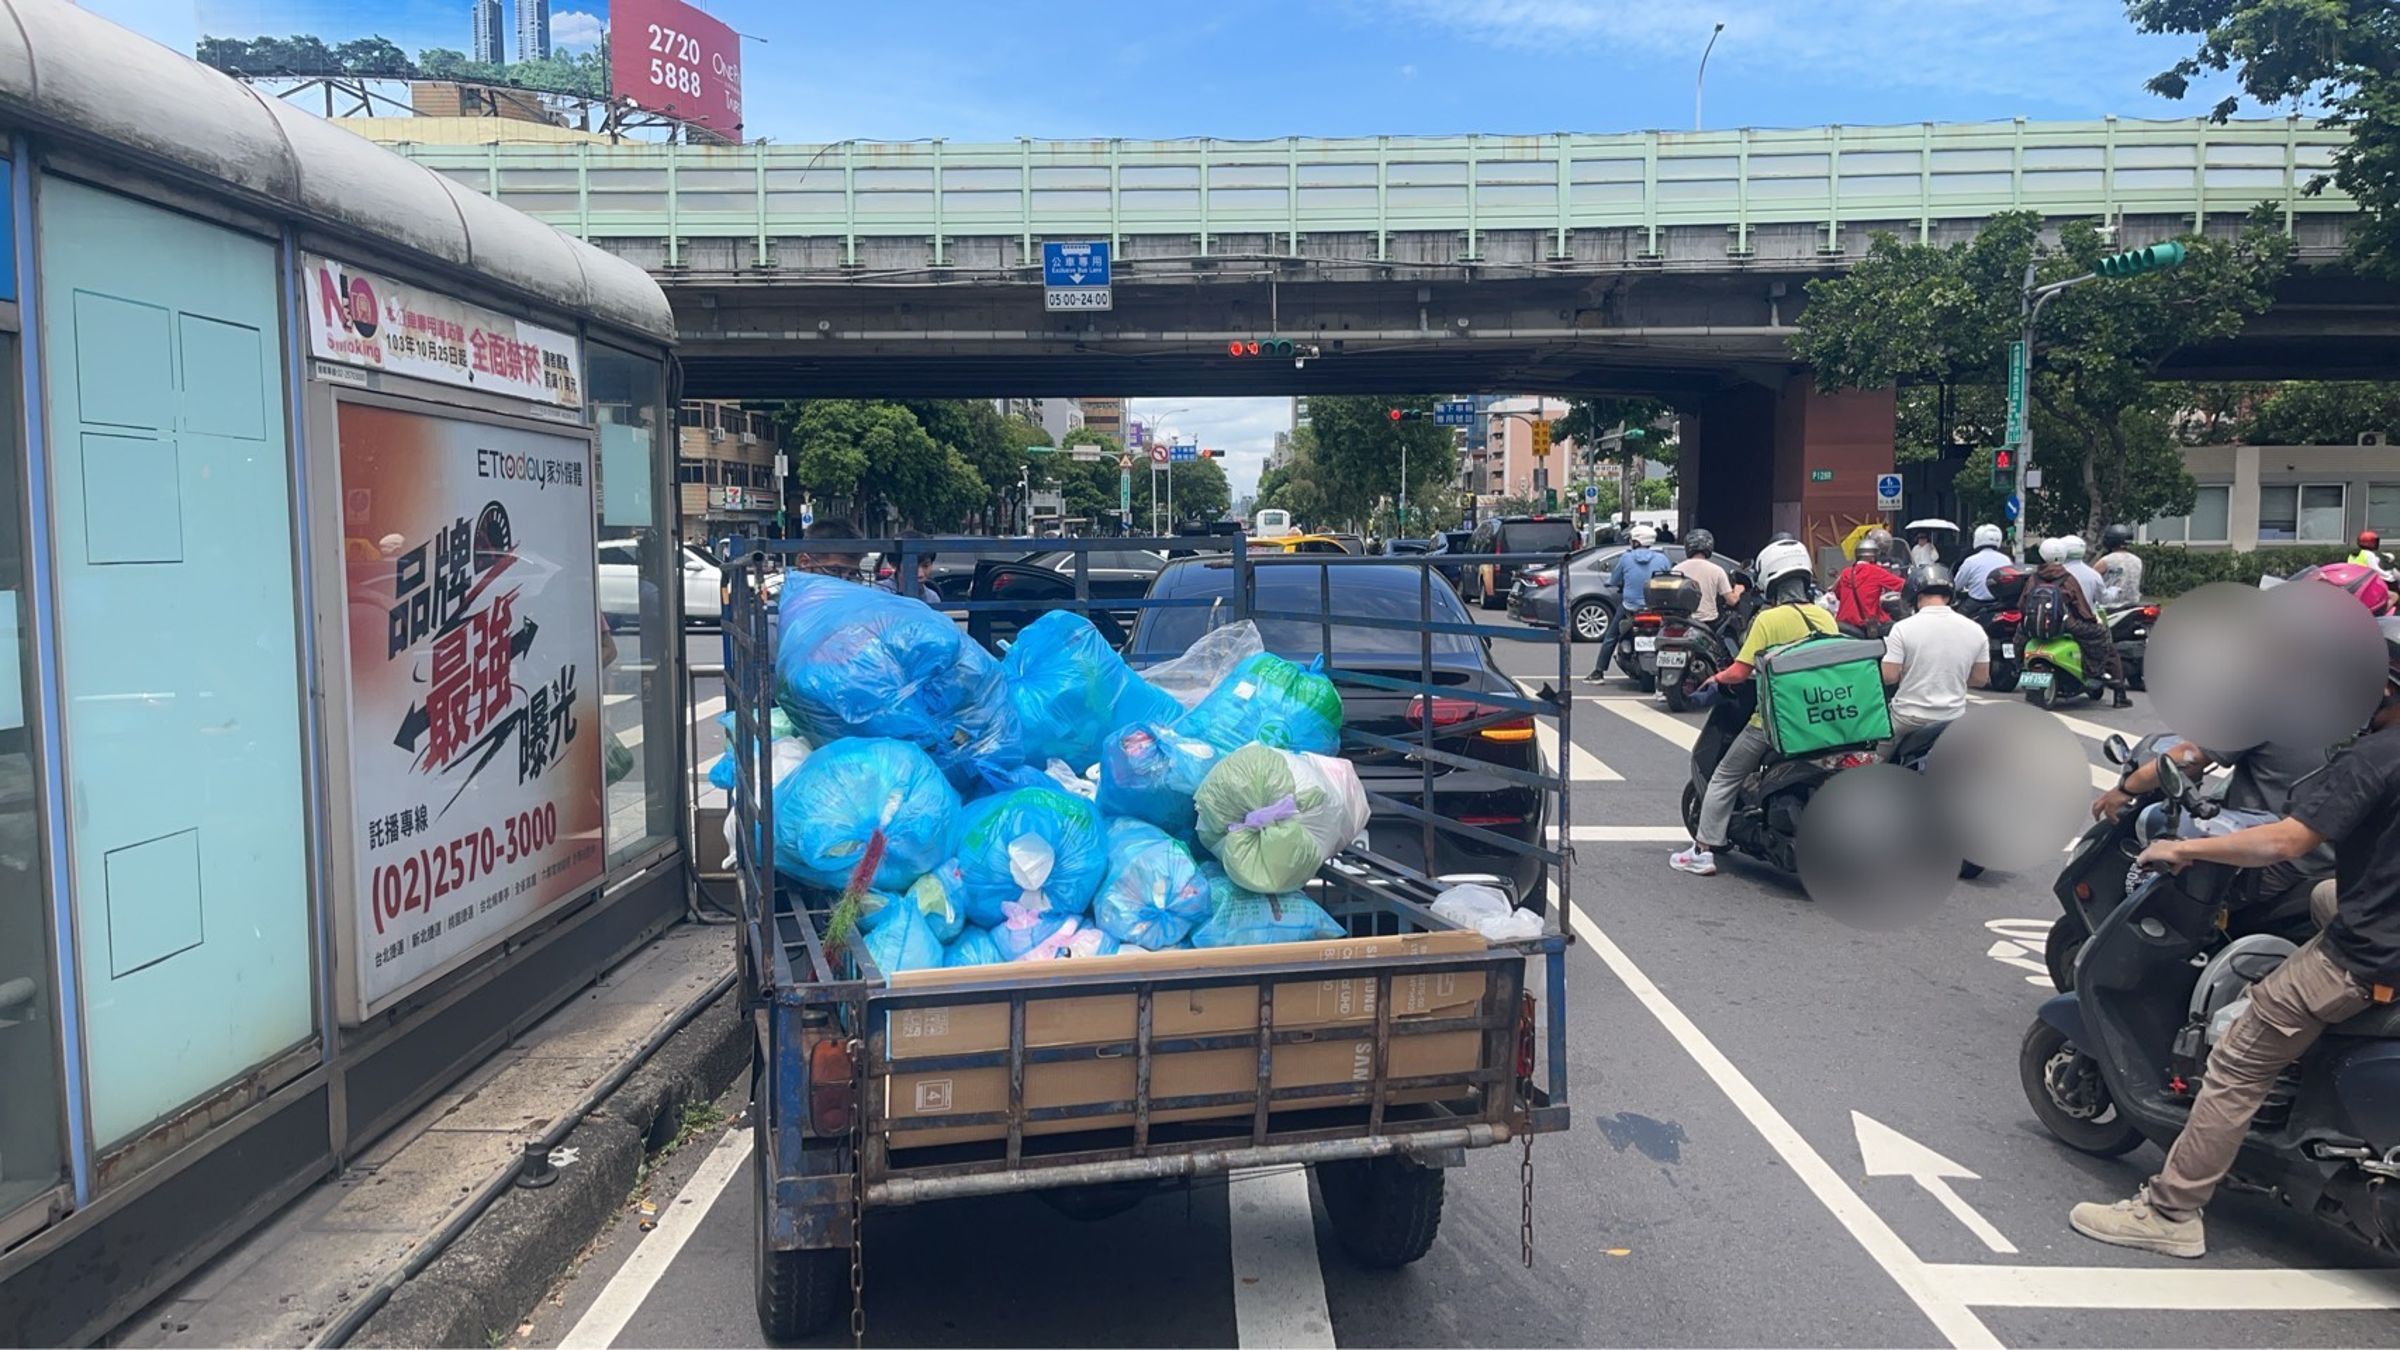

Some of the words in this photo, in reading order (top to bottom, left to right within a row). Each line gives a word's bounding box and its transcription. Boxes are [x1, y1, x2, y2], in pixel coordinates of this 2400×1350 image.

[648, 24, 700, 65] 2720
[650, 58, 701, 97] 5888
[1051, 255, 1102, 267] 公車專用
[326, 332, 382, 364] Smoking
[477, 448, 546, 491] ETtoday
[388, 516, 473, 660] 品牌
[421, 588, 521, 776] 最強
[1803, 685, 1854, 705] Uber
[518, 664, 578, 786] 曝光
[1806, 704, 1859, 725] Eats
[369, 803, 429, 850] 託播專線
[372, 801, 557, 935] (02)2570-3000
[1363, 945, 1378, 1013] SSUNG
